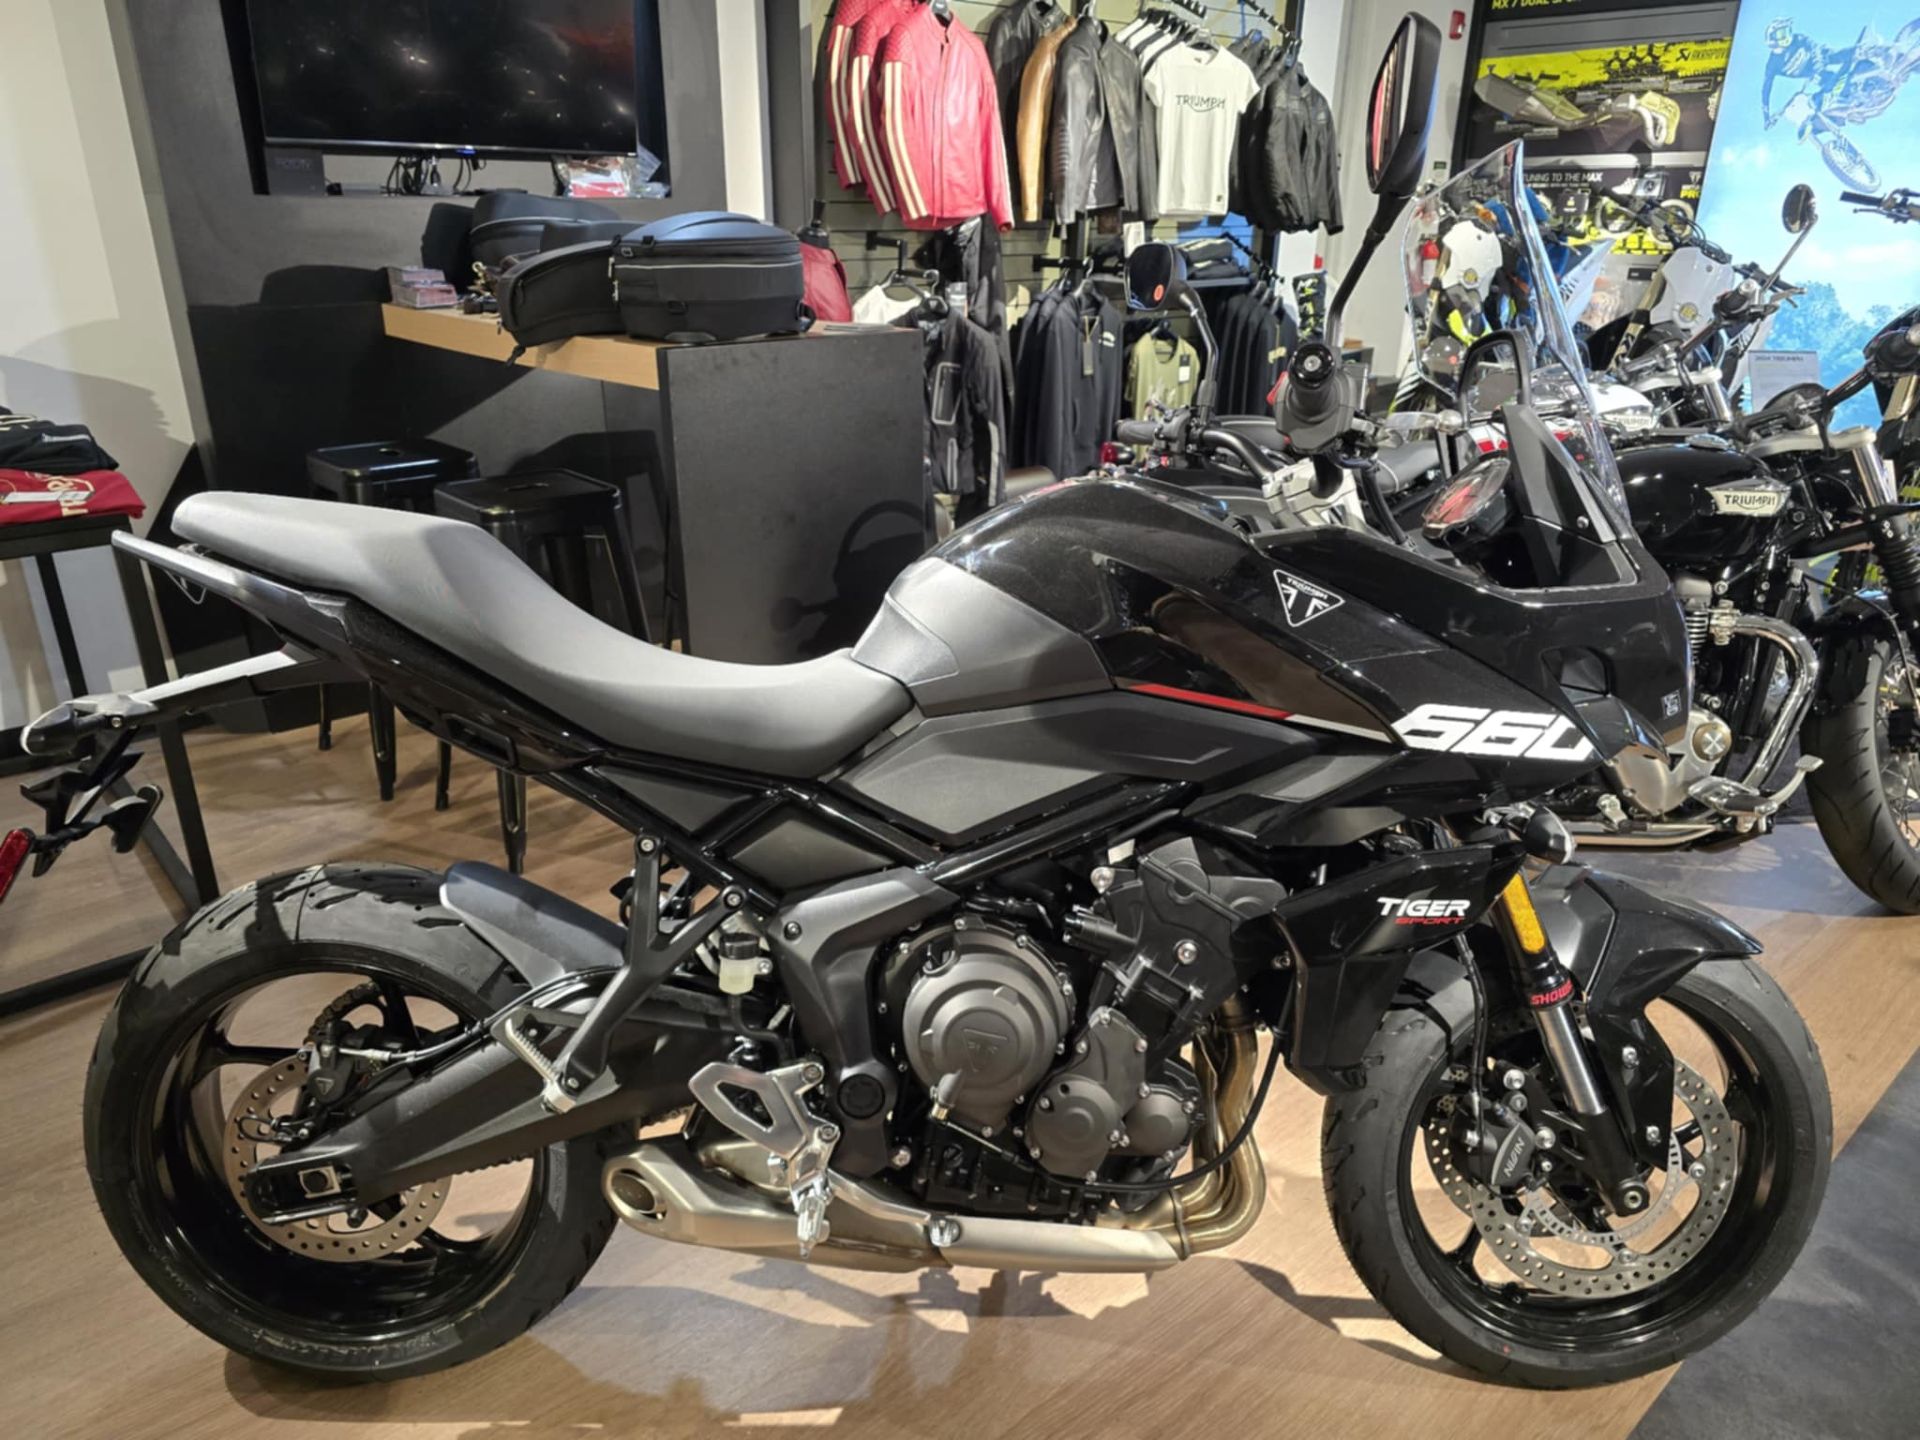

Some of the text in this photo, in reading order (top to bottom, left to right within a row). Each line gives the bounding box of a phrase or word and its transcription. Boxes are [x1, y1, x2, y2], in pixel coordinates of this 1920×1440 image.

[1175, 94, 1226, 112] TRIUMPH
[1552, 173, 1563, 182] TO
[1565, 173, 1581, 182] THE
[1582, 172, 1604, 182] MAX
[1724, 494, 1776, 510] TRIUMPH
[1391, 703, 1594, 761] 660
[1377, 897, 1471, 916] TIGER
[1395, 917, 1465, 925] SPORT
